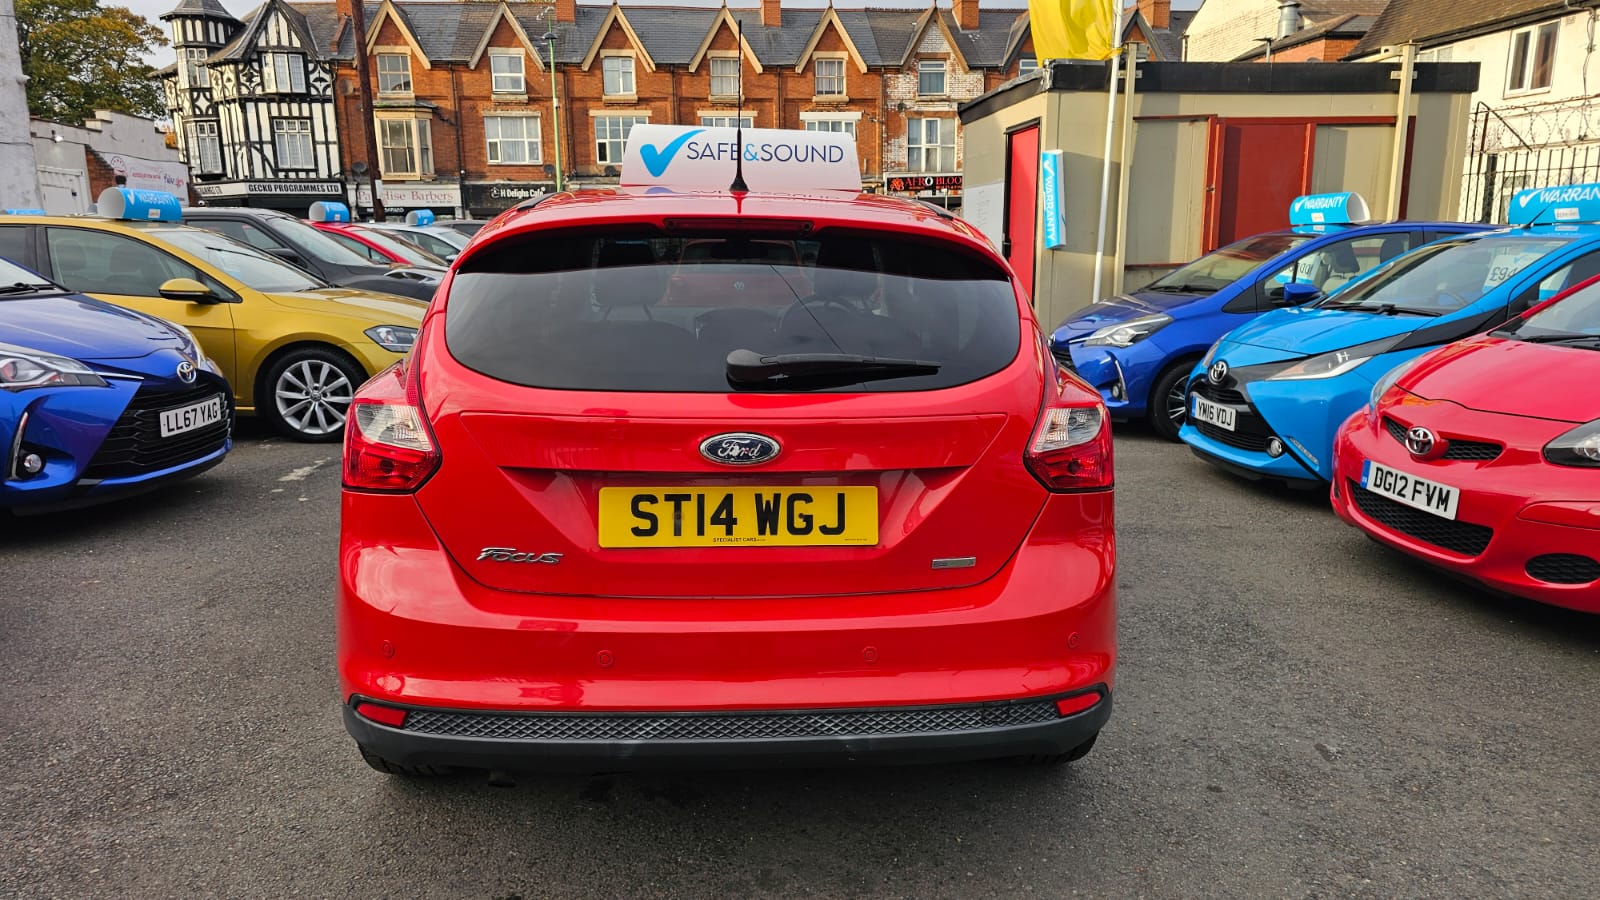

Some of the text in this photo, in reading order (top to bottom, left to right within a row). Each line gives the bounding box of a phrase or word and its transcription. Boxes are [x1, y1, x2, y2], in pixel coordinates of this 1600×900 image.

[687, 141, 844, 163] SAFE&SOUND
[248, 183, 339, 192] GECKO PROGRAMMES LTD
[905, 176, 934, 186] AFRO
[357, 190, 454, 201] Padise Barbers
[1304, 195, 1346, 210] WARRANTY
[1045, 175, 1056, 240] WARRANTY
[166, 402, 218, 432] LL67 YAG
[1216, 407, 1233, 426] VDJ
[718, 439, 761, 457] Ford
[1373, 466, 1451, 513] DG12 FVM
[630, 492, 846, 537] ST14 WGJ
